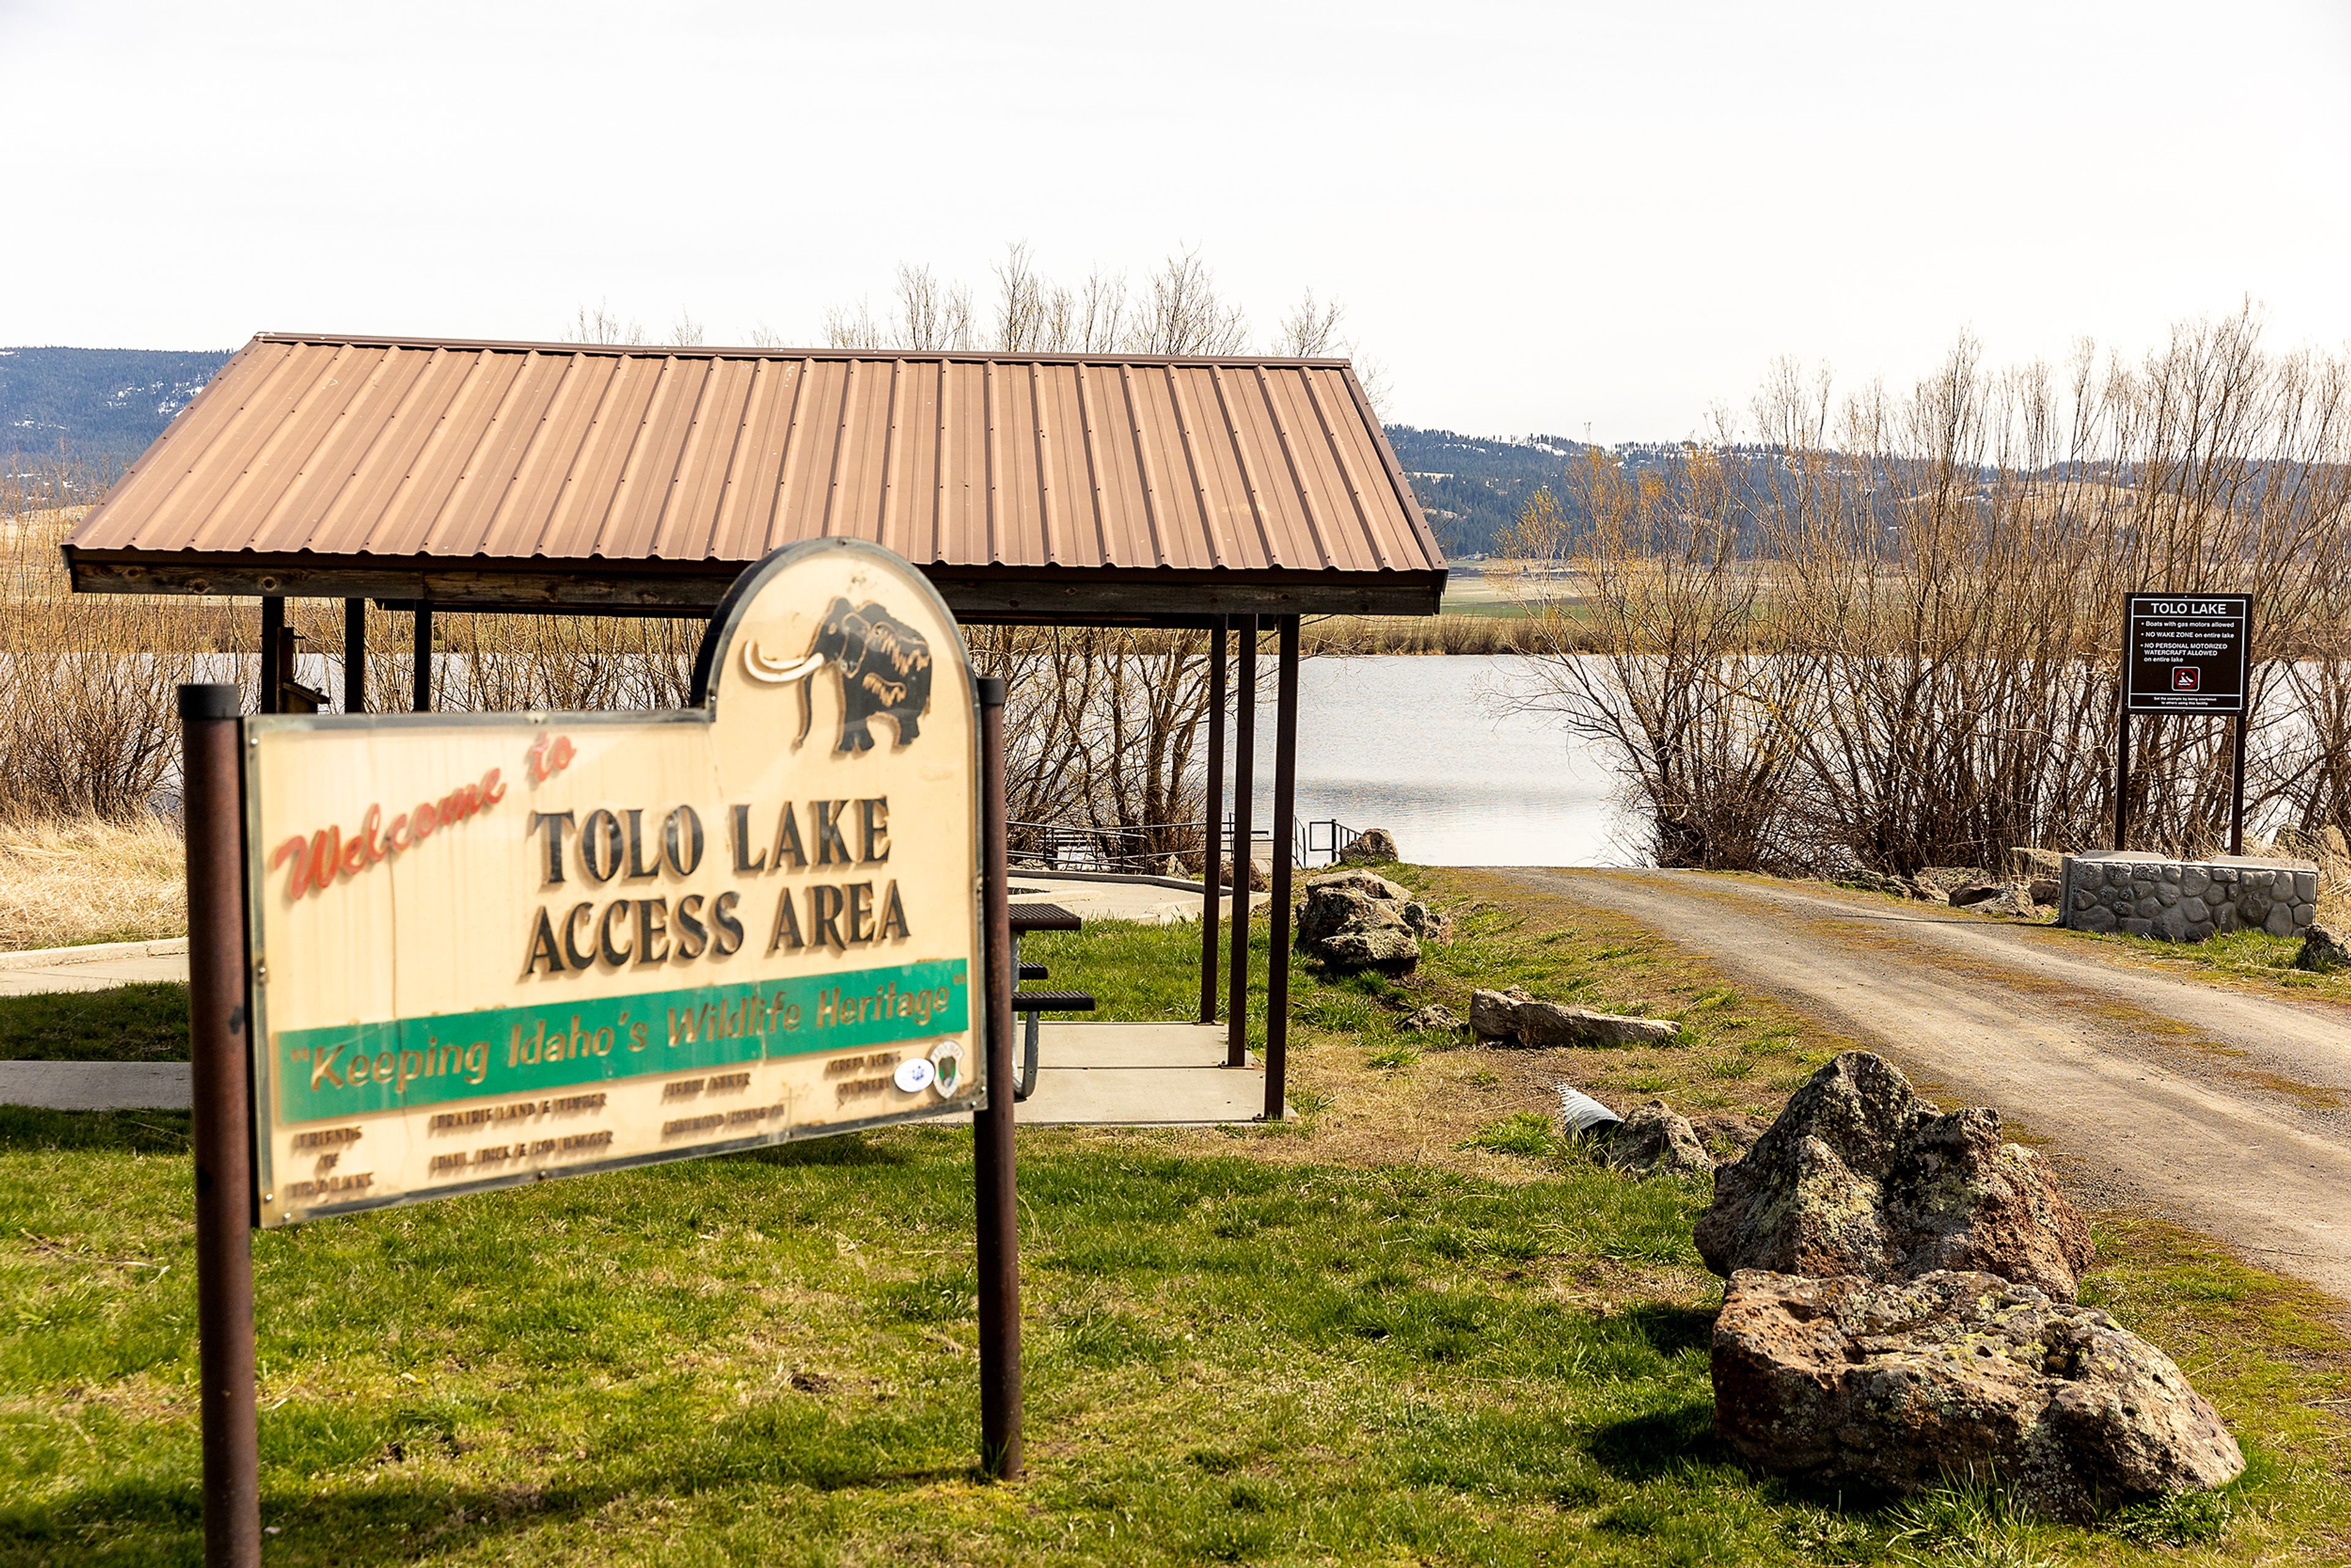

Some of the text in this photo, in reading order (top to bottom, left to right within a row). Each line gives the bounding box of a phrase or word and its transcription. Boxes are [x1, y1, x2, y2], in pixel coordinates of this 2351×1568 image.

[2151, 603, 2227, 614] TOLO LAKE
[274, 731, 577, 900] Welcome to
[528, 795, 891, 886] TOLO LAKE
[522, 879, 911, 976] ACCESS AREA
[290, 972, 966, 1094] "Keeping Idaho's Wildlife Heritage"
[495, 1103, 535, 1120] LAND
